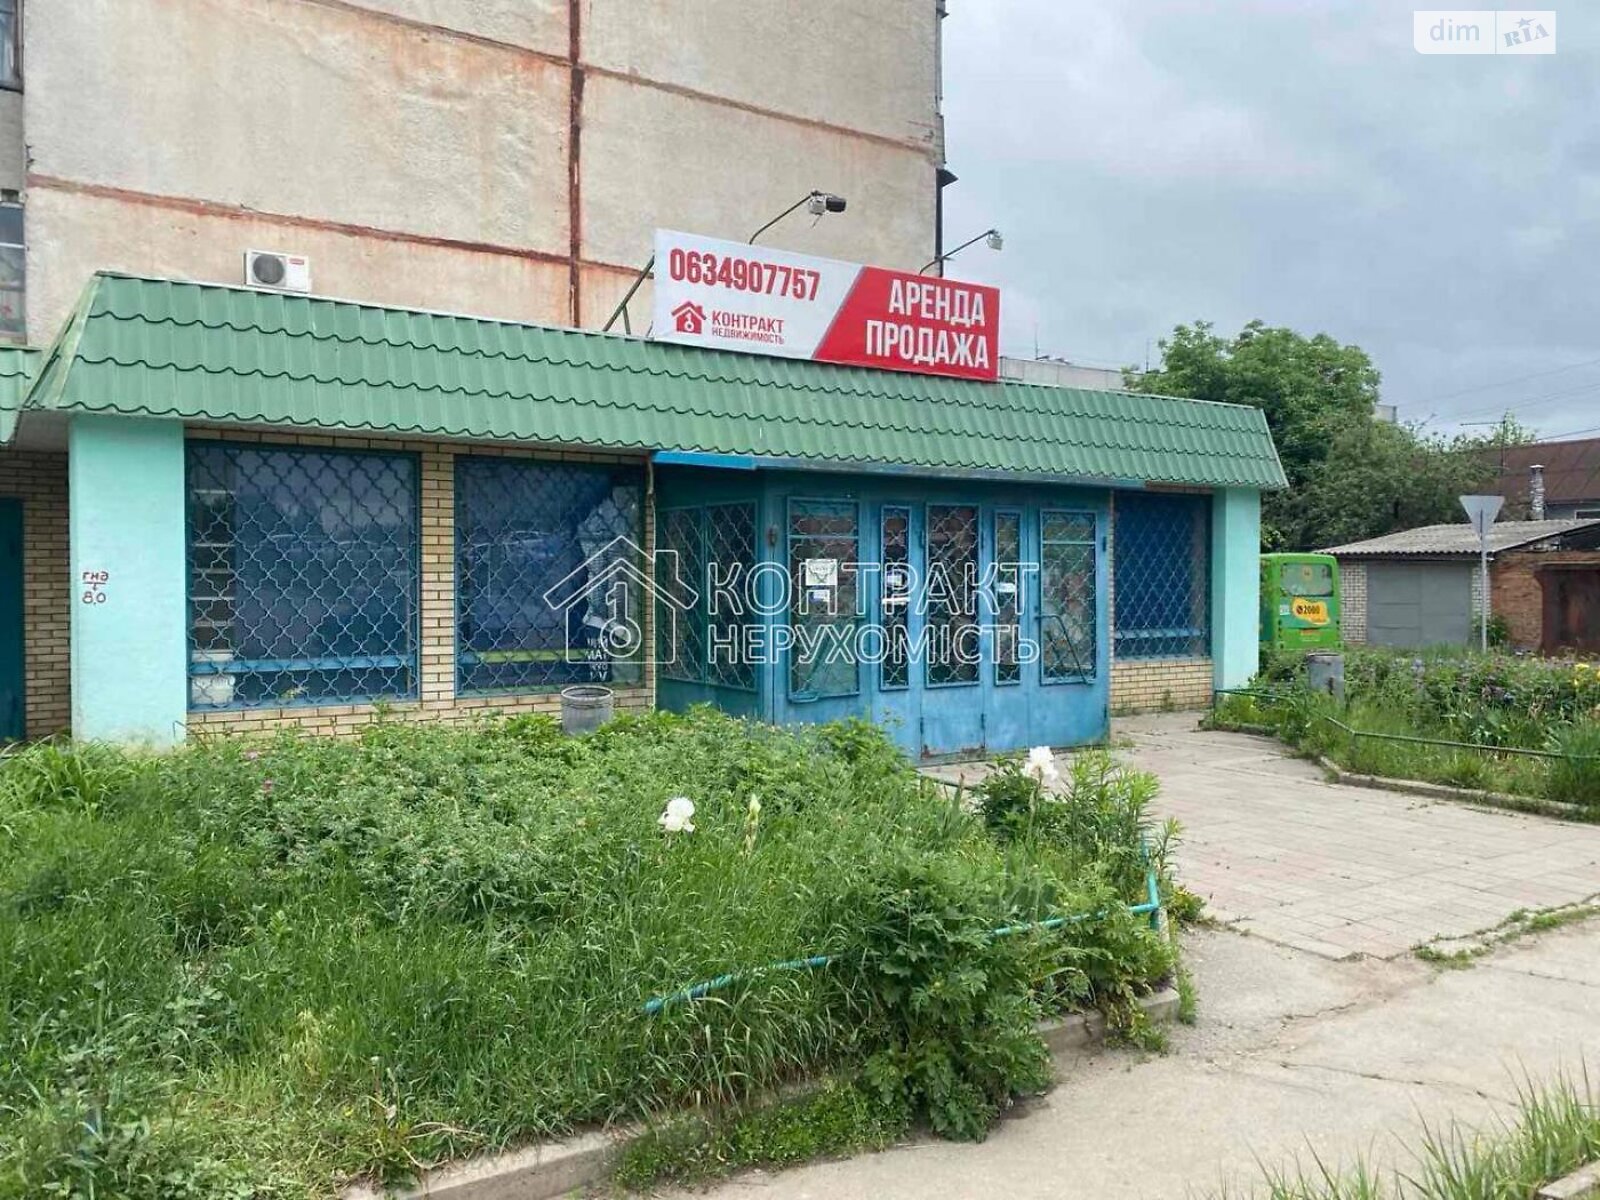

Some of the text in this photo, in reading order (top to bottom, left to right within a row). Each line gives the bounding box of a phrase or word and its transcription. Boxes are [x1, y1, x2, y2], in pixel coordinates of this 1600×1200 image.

[670, 248, 820, 301] 0634907757
[711, 309, 784, 333] КОНТРАКТ
[888, 278, 986, 327] АРЕНДА
[711, 326, 784, 345] НЕДВИЖИМОСТЬ
[865, 318, 989, 369] ПРОДАЖА
